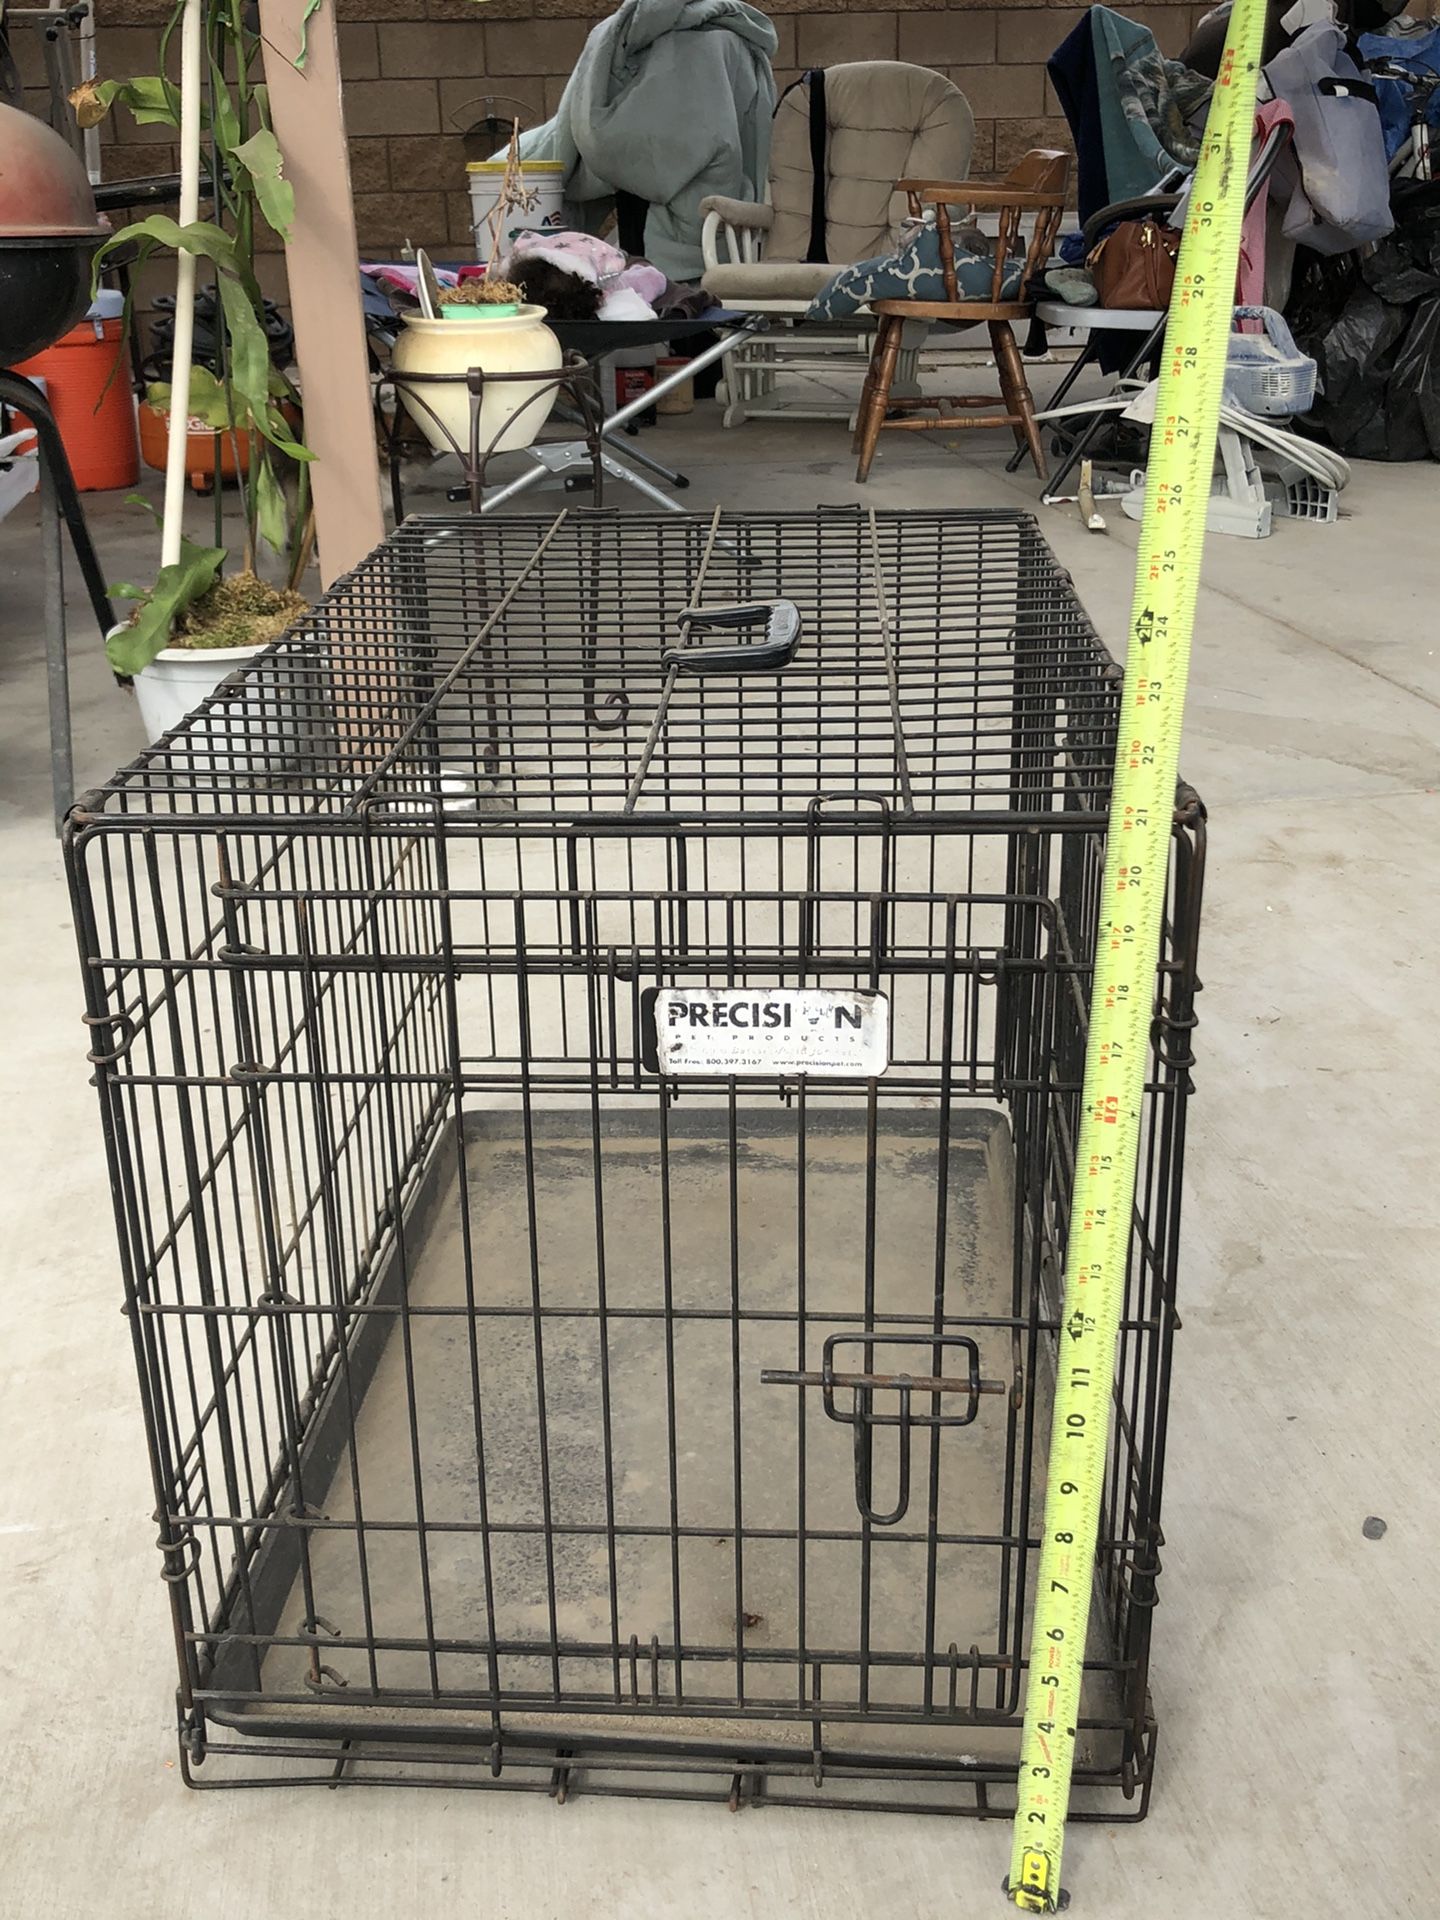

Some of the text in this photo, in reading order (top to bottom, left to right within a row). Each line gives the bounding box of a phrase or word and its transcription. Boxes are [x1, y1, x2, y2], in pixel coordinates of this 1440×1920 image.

[1211, 132, 1222, 154] 31
[1201, 202, 1213, 227] 30
[1192, 274, 1205, 299] 29
[1184, 347, 1197, 369] 28
[1177, 416, 1189, 437] 27
[1170, 484, 1182, 505] 26
[1162, 550, 1176, 572] 25
[1155, 615, 1168, 637] 24
[1150, 682, 1162, 701] 23
[1142, 745, 1154, 764] 22
[1136, 808, 1148, 826] 21
[1129, 866, 1142, 887] 20
[1123, 925, 1135, 943] 19
[1117, 984, 1129, 1001] 18
[667, 1002, 862, 1029] PRECISIN
[1111, 1042, 1123, 1058] 17
[1100, 1155, 1112, 1170] 15
[1095, 1209, 1107, 1225] 14
[1090, 1263, 1102, 1279] 13
[1084, 1317, 1096, 1332] 12
[1071, 1368, 1090, 1389] 11
[1066, 1413, 1086, 1438] 10
[1060, 1481, 1079, 1495] 9
[1055, 1532, 1073, 1544] 8
[1051, 1580, 1069, 1594] 7
[1046, 1628, 1064, 1641] 6
[1041, 1675, 1059, 1688] 5
[1037, 1721, 1055, 1734] 4
[1032, 1767, 1050, 1778] 3
[1028, 1812, 1046, 1825] 2
